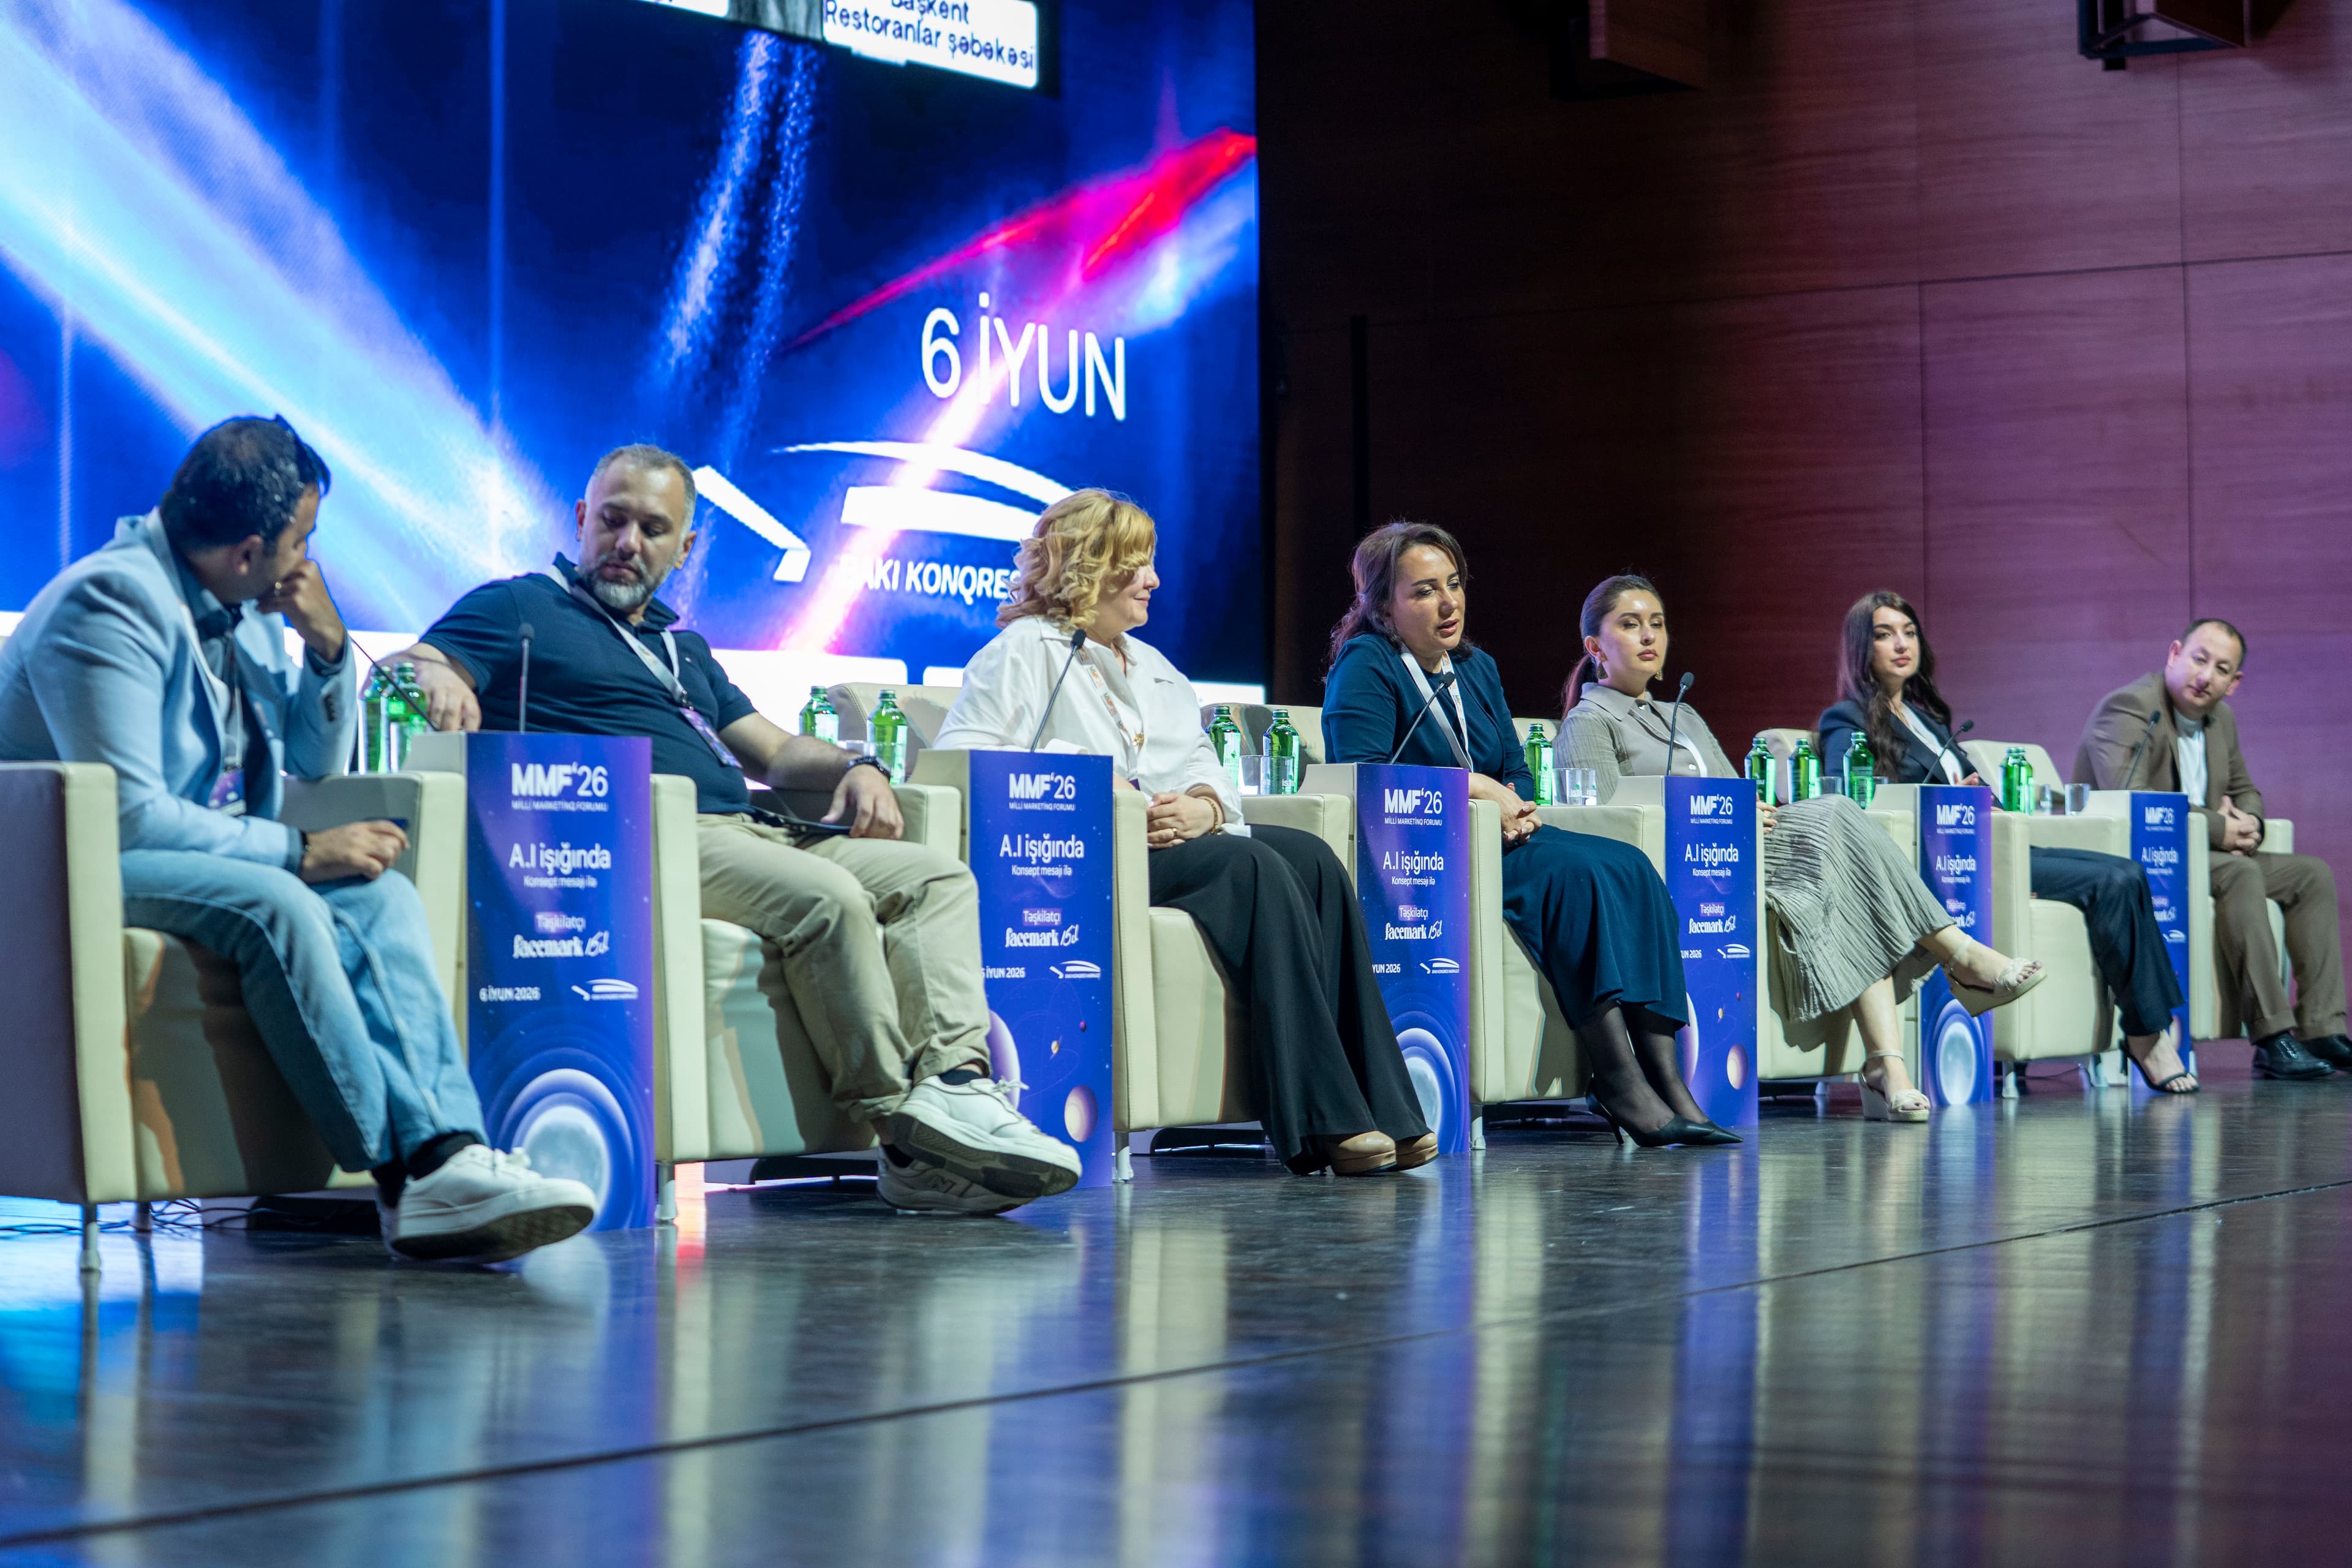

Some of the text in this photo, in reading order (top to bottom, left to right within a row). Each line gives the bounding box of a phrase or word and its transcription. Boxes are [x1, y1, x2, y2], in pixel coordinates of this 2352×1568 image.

[823, 0, 1034, 69] Restoranlar şəbəkəsi
[922, 292, 1126, 421] 6 İYUN
[511, 761, 609, 797] MMF'26
[1009, 772, 1076, 799] MMF'26
[1054, 803, 1076, 812] FORUMU
[1385, 788, 1442, 814] MMF'26
[1691, 794, 1733, 815] MMF'26
[1936, 803, 1975, 825] MMF'26
[509, 842, 611, 876] A.I işığında
[1000, 833, 1084, 864] A.I işığında
[1684, 843, 1739, 867] A.I işığında
[1012, 865, 1040, 877] Konsept
[1382, 850, 1444, 876] A.I işığında
[1392, 876, 1412, 886] Konsept
[1023, 910, 1061, 925] Təşkilatçı
[1399, 907, 1428, 921] Təşkilatçı
[1385, 922, 1427, 940] facemark
[1689, 918, 1723, 933] facemark
[512, 934, 584, 959] facemark
[1005, 927, 1059, 948] facemark
[1689, 949, 1702, 959] 2026
[986, 965, 1005, 979] İYUN
[1006, 967, 1026, 979] 2026
[1372, 963, 1401, 973] YUN 2026
[479, 985, 541, 1002] 6 İYUN 2026
